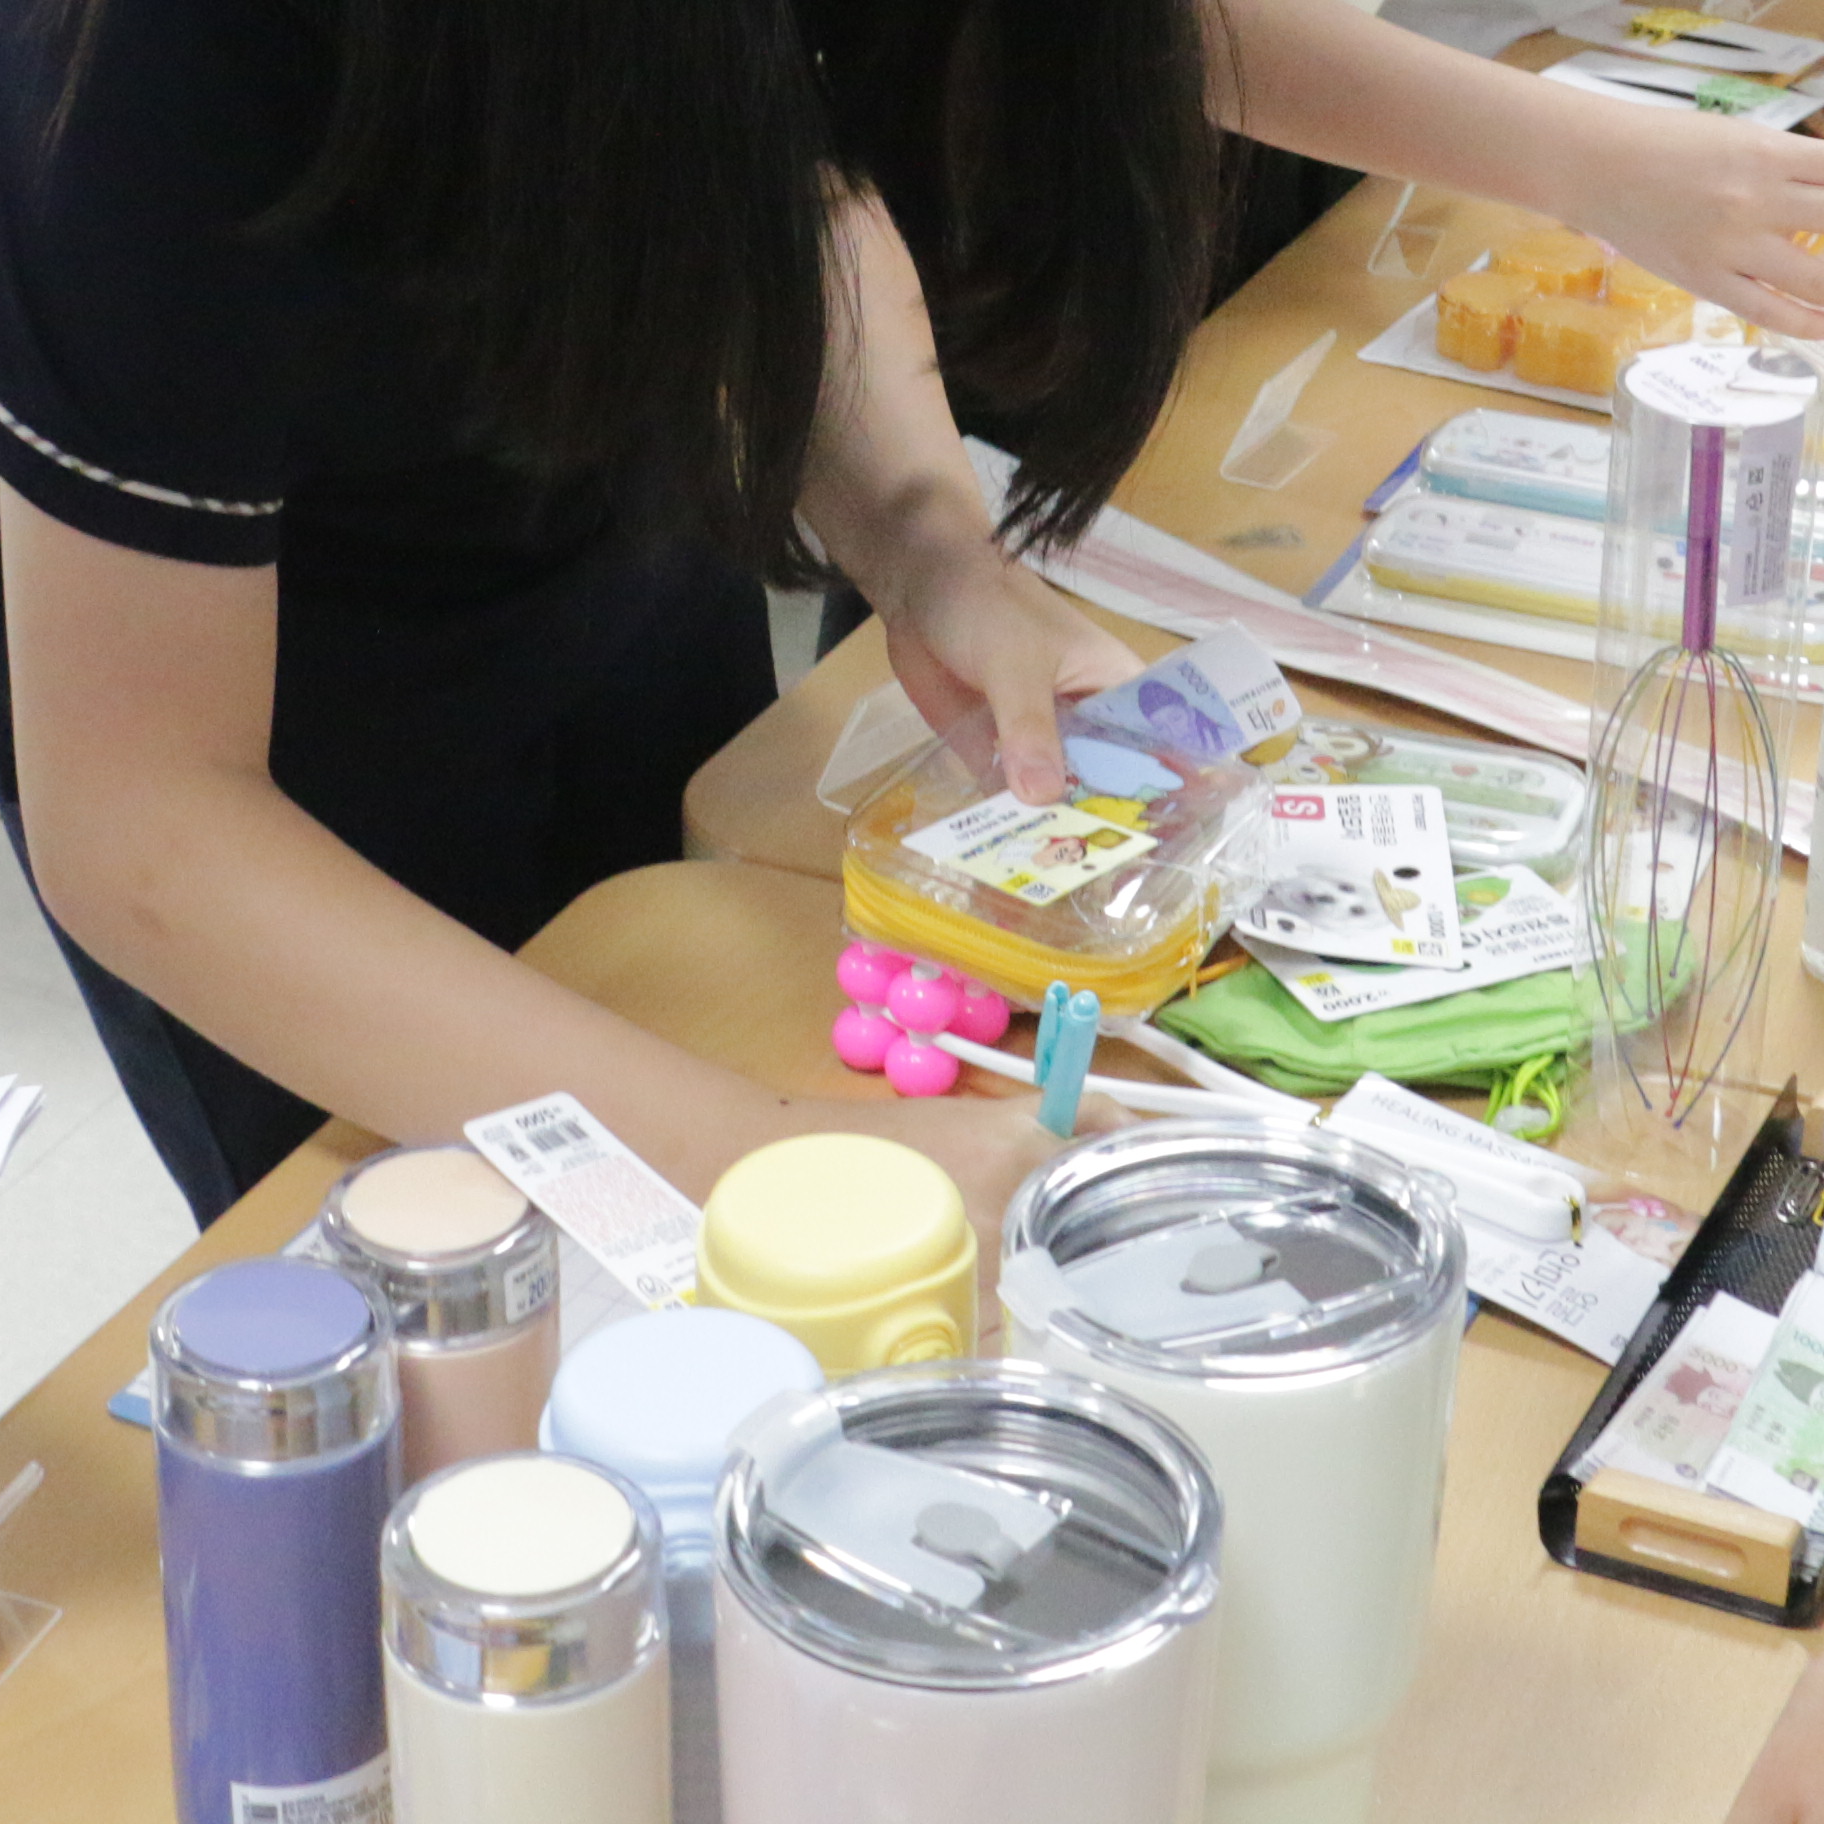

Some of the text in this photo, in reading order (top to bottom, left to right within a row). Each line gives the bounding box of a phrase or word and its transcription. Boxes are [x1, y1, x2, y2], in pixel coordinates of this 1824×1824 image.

[1370, 1090, 1463, 1142] HEALING
[1502, 1248, 1580, 1309] 안마기
[1688, 1346, 1739, 1374] 5000
